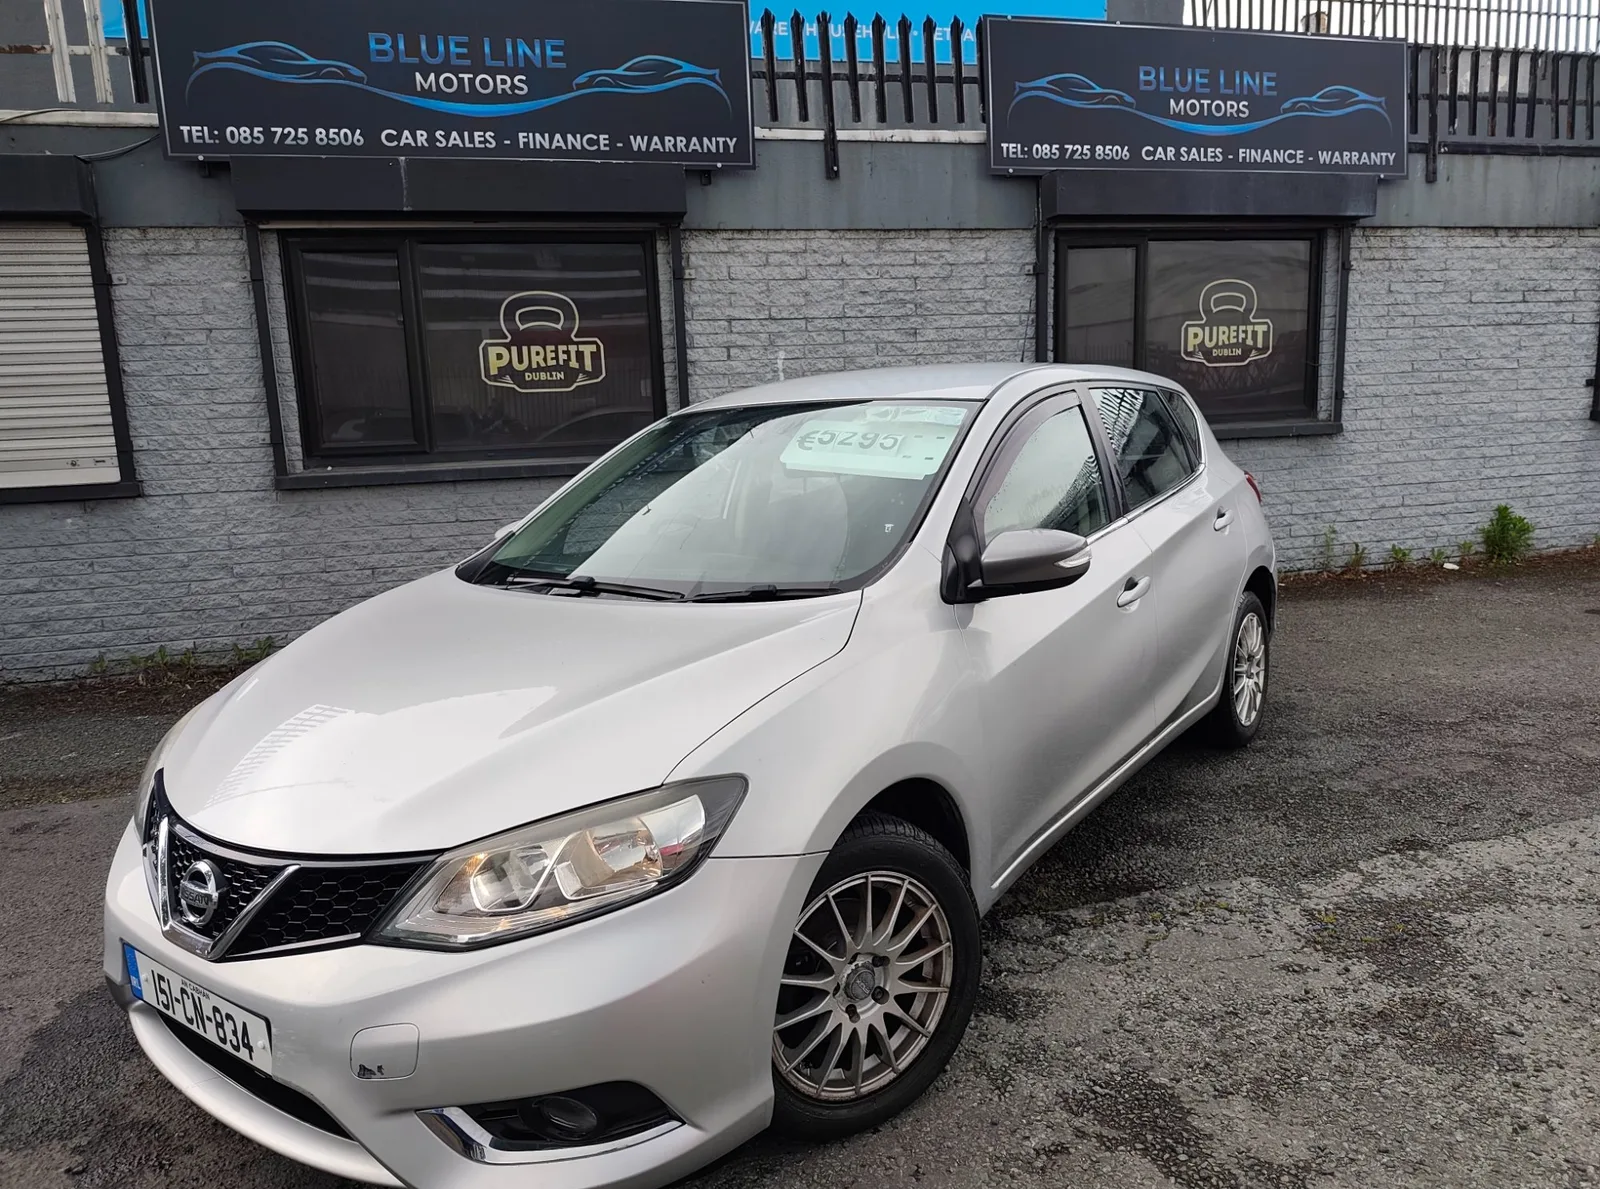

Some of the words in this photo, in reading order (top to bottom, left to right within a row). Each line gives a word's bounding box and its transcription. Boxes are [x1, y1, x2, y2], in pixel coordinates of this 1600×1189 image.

[367, 31, 471, 66] BLUE
[483, 36, 566, 70] LINE
[415, 71, 529, 97] MOTORS
[1138, 65, 1211, 93] BLUE
[1219, 69, 1278, 96] LINE
[1169, 98, 1250, 119] MOTORS
[179, 125, 220, 144] TEL:
[225, 126, 265, 145] 085
[270, 127, 309, 145] 725
[315, 127, 364, 146] 8506
[380, 129, 429, 147] CAR
[434, 130, 497, 149] SALES
[518, 132, 610, 151] FINANCE
[629, 135, 738, 154] WARRANTY
[1000, 142, 1029, 159] TEL:
[1032, 143, 1060, 160] 085
[1064, 144, 1091, 160] 725
[1095, 145, 1130, 161] 8506
[1141, 145, 1176, 161] CAR
[1179, 146, 1223, 163] SALES
[1238, 148, 1304, 164] FINANCE
[1317, 150, 1396, 166] WARRANTY
[1186, 324, 1268, 352] PUREFIT
[487, 344, 597, 376] PUREFIT
[1212, 347, 1242, 357] DUBLIN
[524, 371, 565, 382] DUBLIN
[797, 429, 903, 451] €5295
[151, 969, 254, 1061] 151-CN-834
